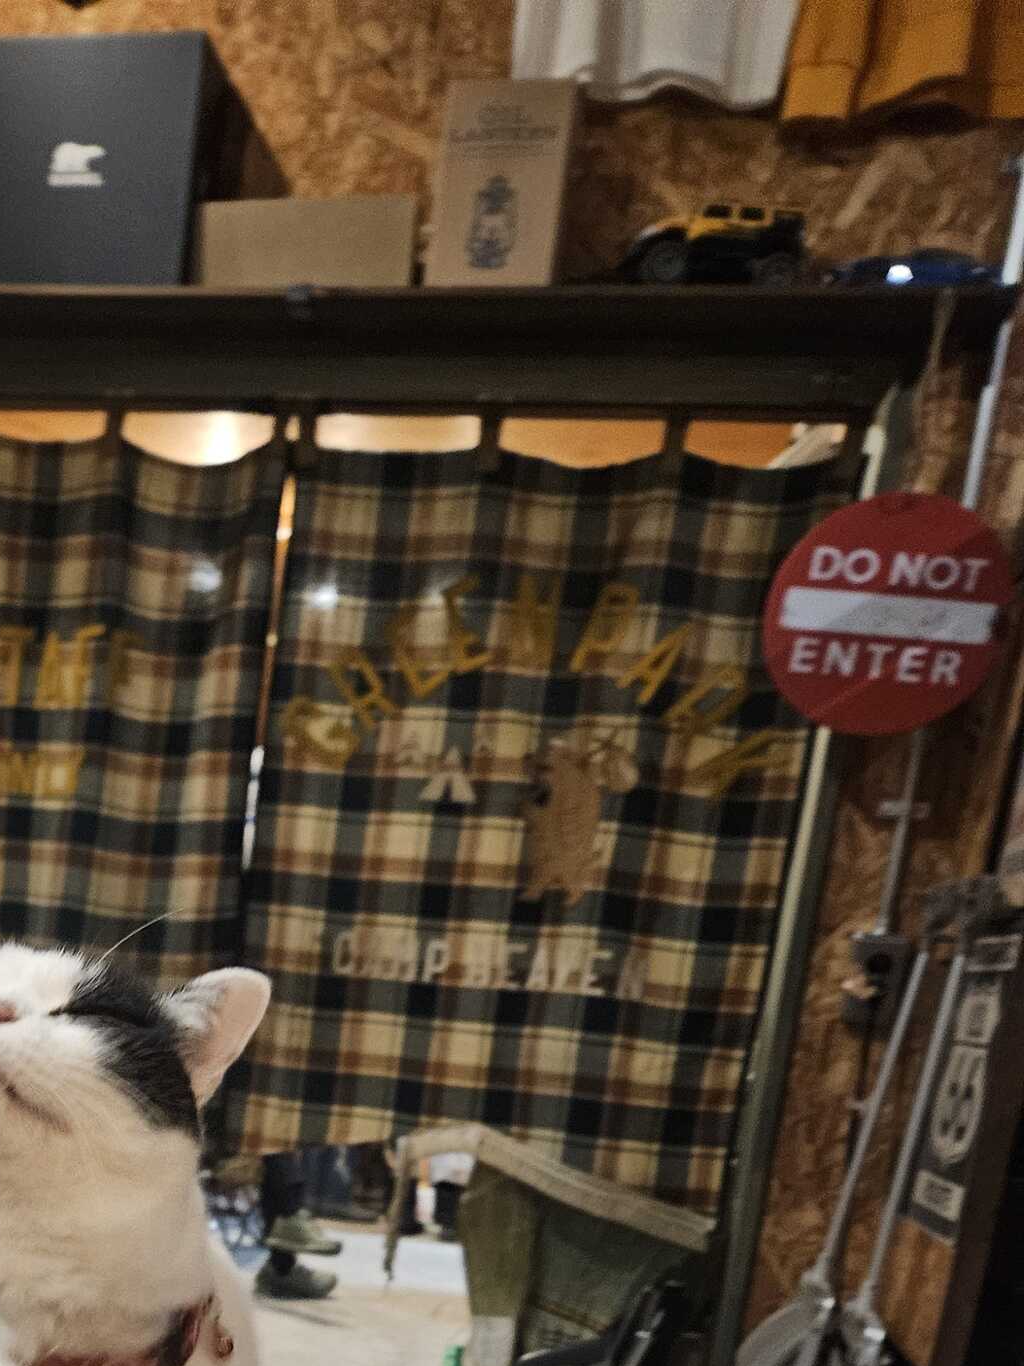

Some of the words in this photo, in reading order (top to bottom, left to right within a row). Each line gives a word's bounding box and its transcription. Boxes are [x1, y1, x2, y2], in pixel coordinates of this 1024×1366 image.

[807, 545, 881, 584] DO
[887, 551, 989, 592] NOT
[787, 636, 962, 689] ENTER
